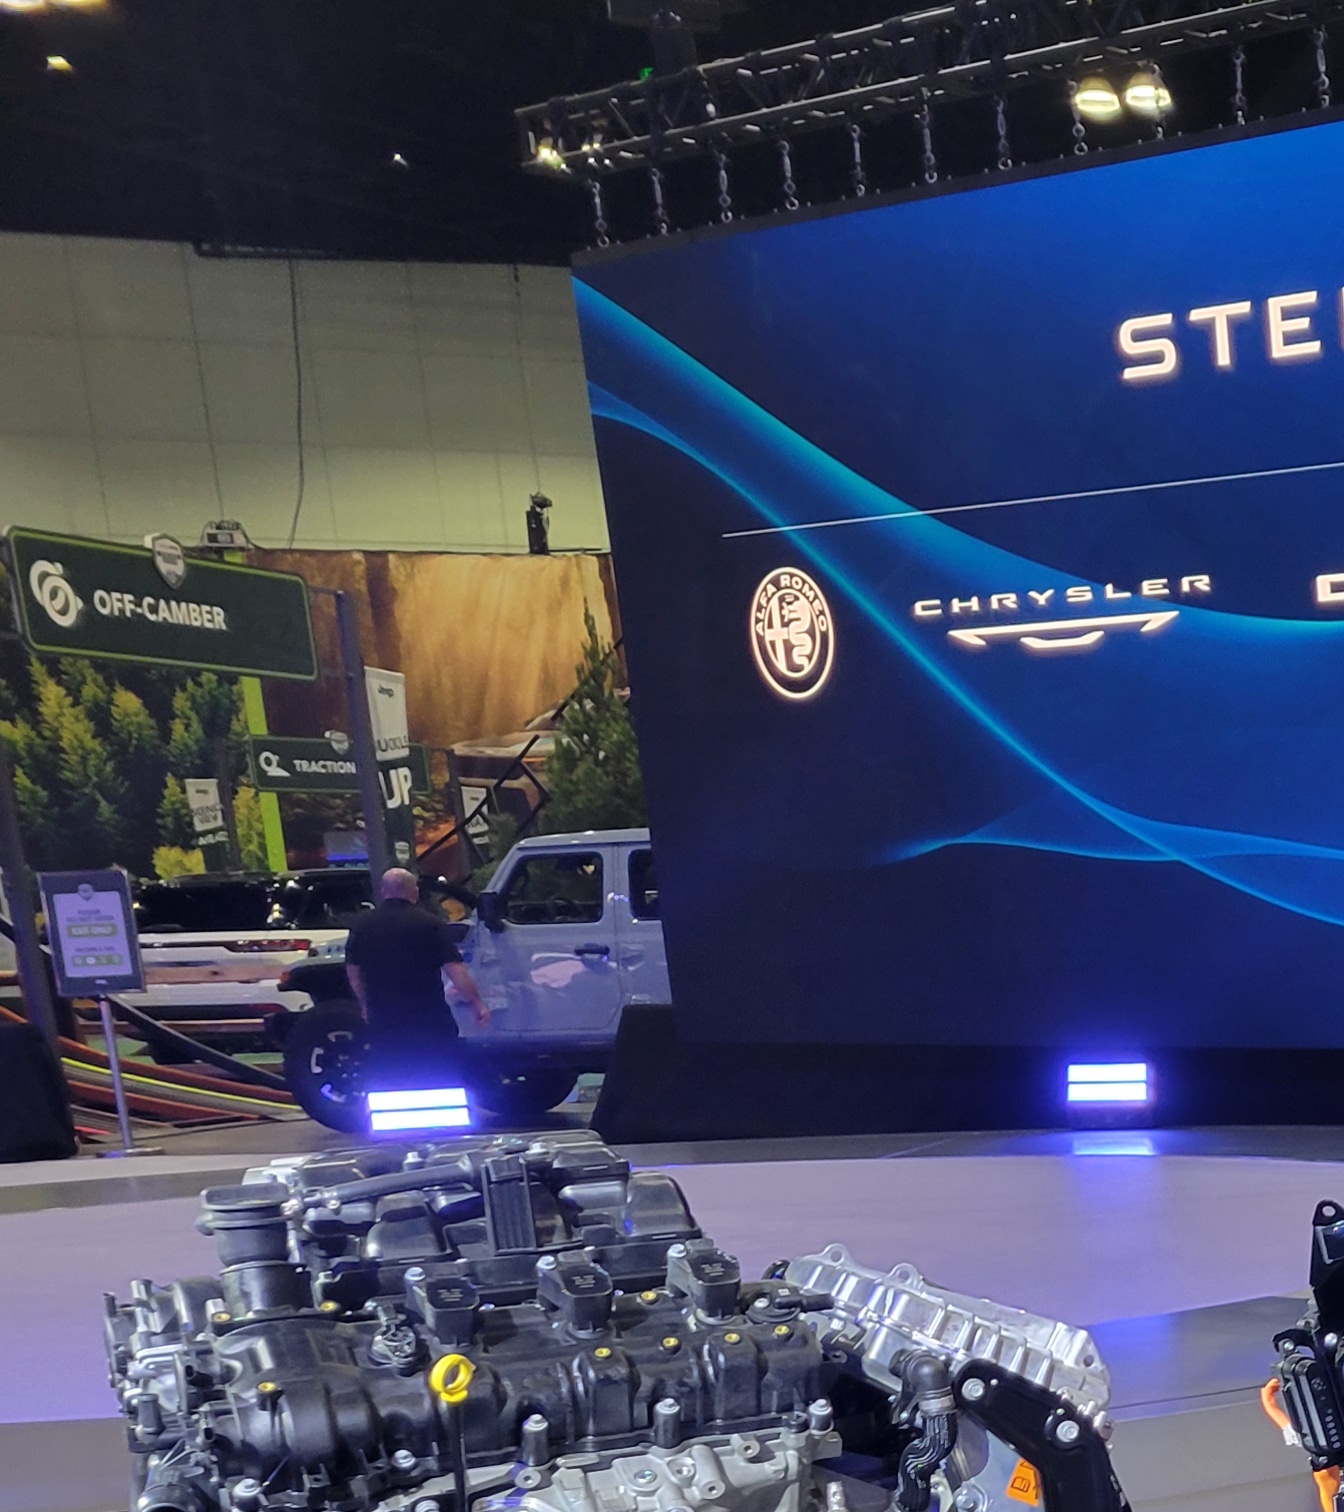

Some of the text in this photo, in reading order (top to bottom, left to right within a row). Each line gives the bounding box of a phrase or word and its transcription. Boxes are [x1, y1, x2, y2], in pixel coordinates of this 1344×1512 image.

[93, 589, 228, 630] OFF-CAMBER
[755, 575, 828, 636] ALFA ROMEO
[913, 574, 1212, 617] CHRYSLER
[292, 759, 357, 774] TRACTION
[378, 766, 413, 809] UP
